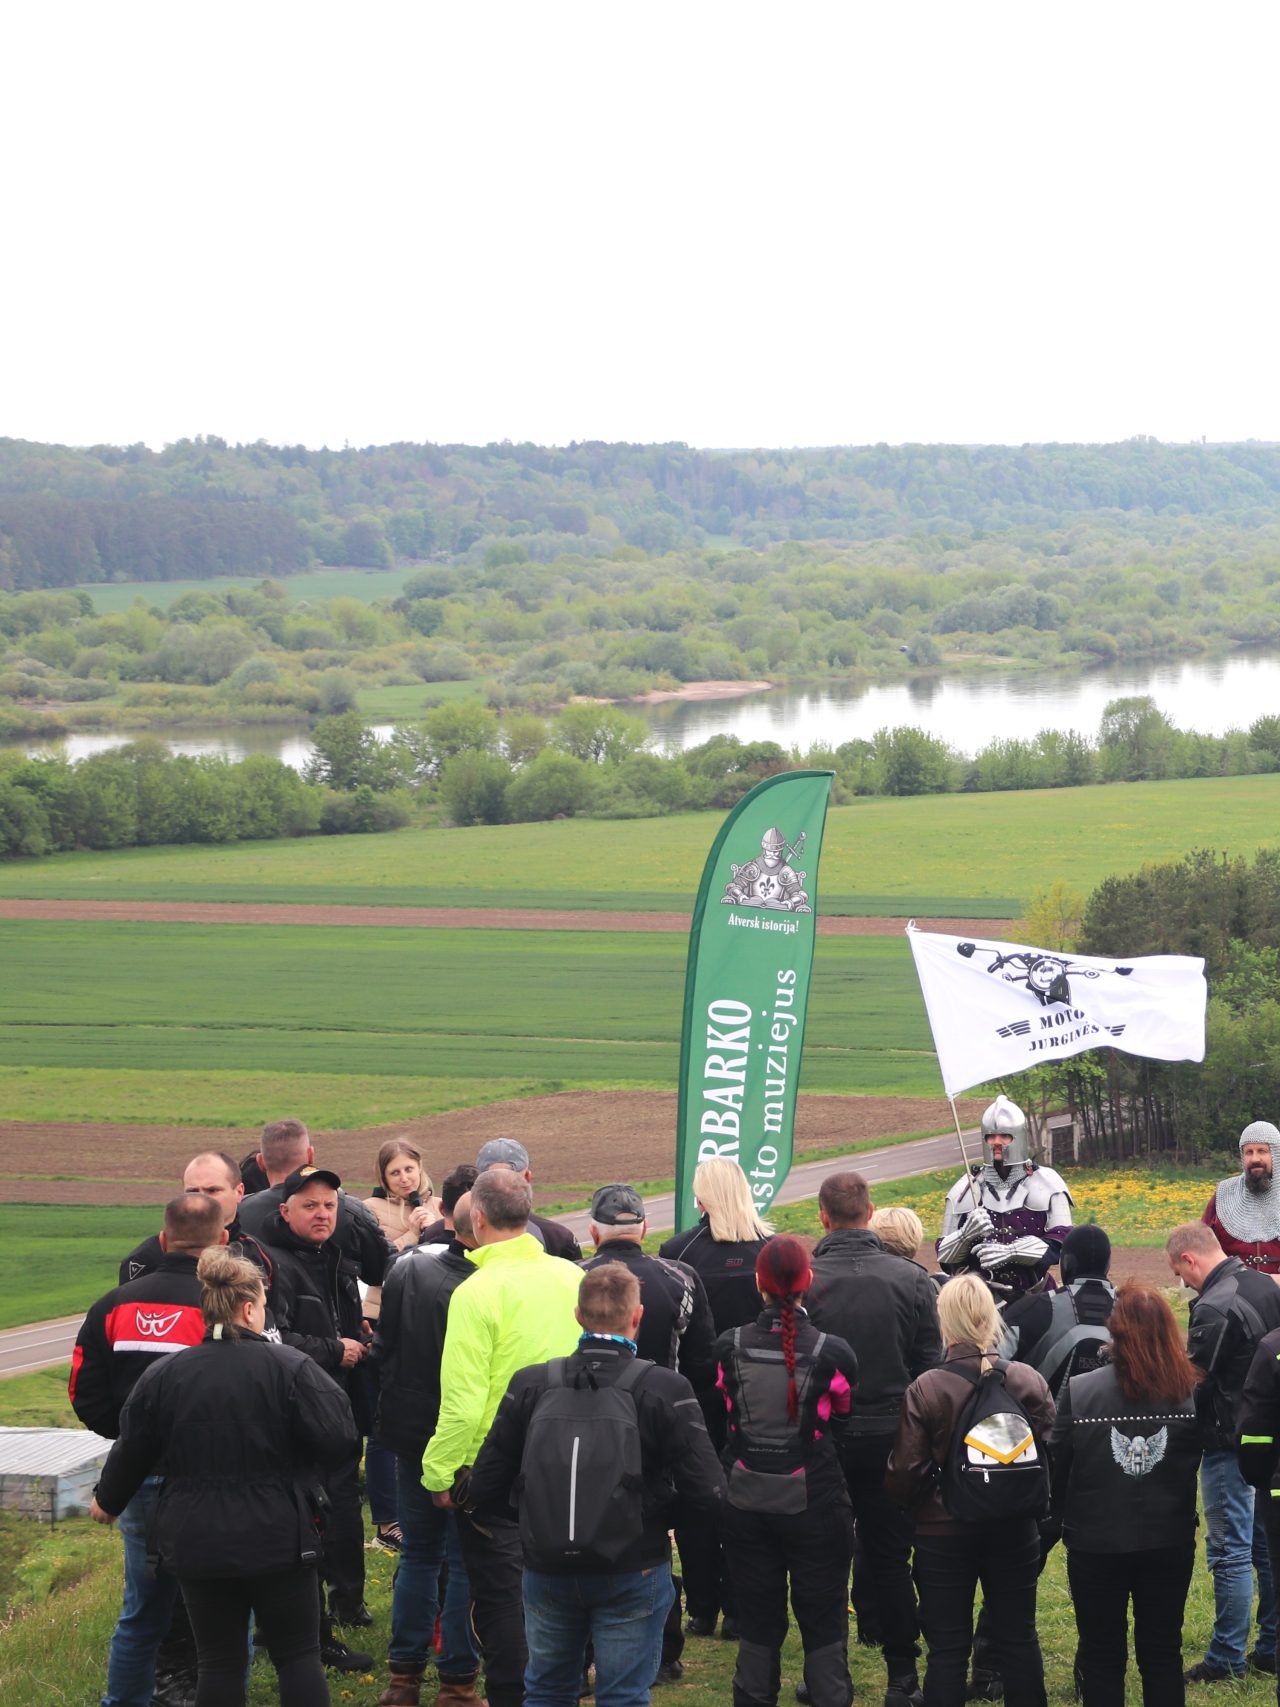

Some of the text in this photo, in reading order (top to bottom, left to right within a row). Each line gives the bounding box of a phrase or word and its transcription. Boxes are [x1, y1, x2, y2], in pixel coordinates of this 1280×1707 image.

[728, 912, 760, 929] Atversk
[1039, 1008, 1085, 1030] MOTO
[757, 968, 798, 1134] muziejus
[1028, 1021, 1100, 1051] JURGINĖS
[697, 999, 753, 1165] RBARKO
